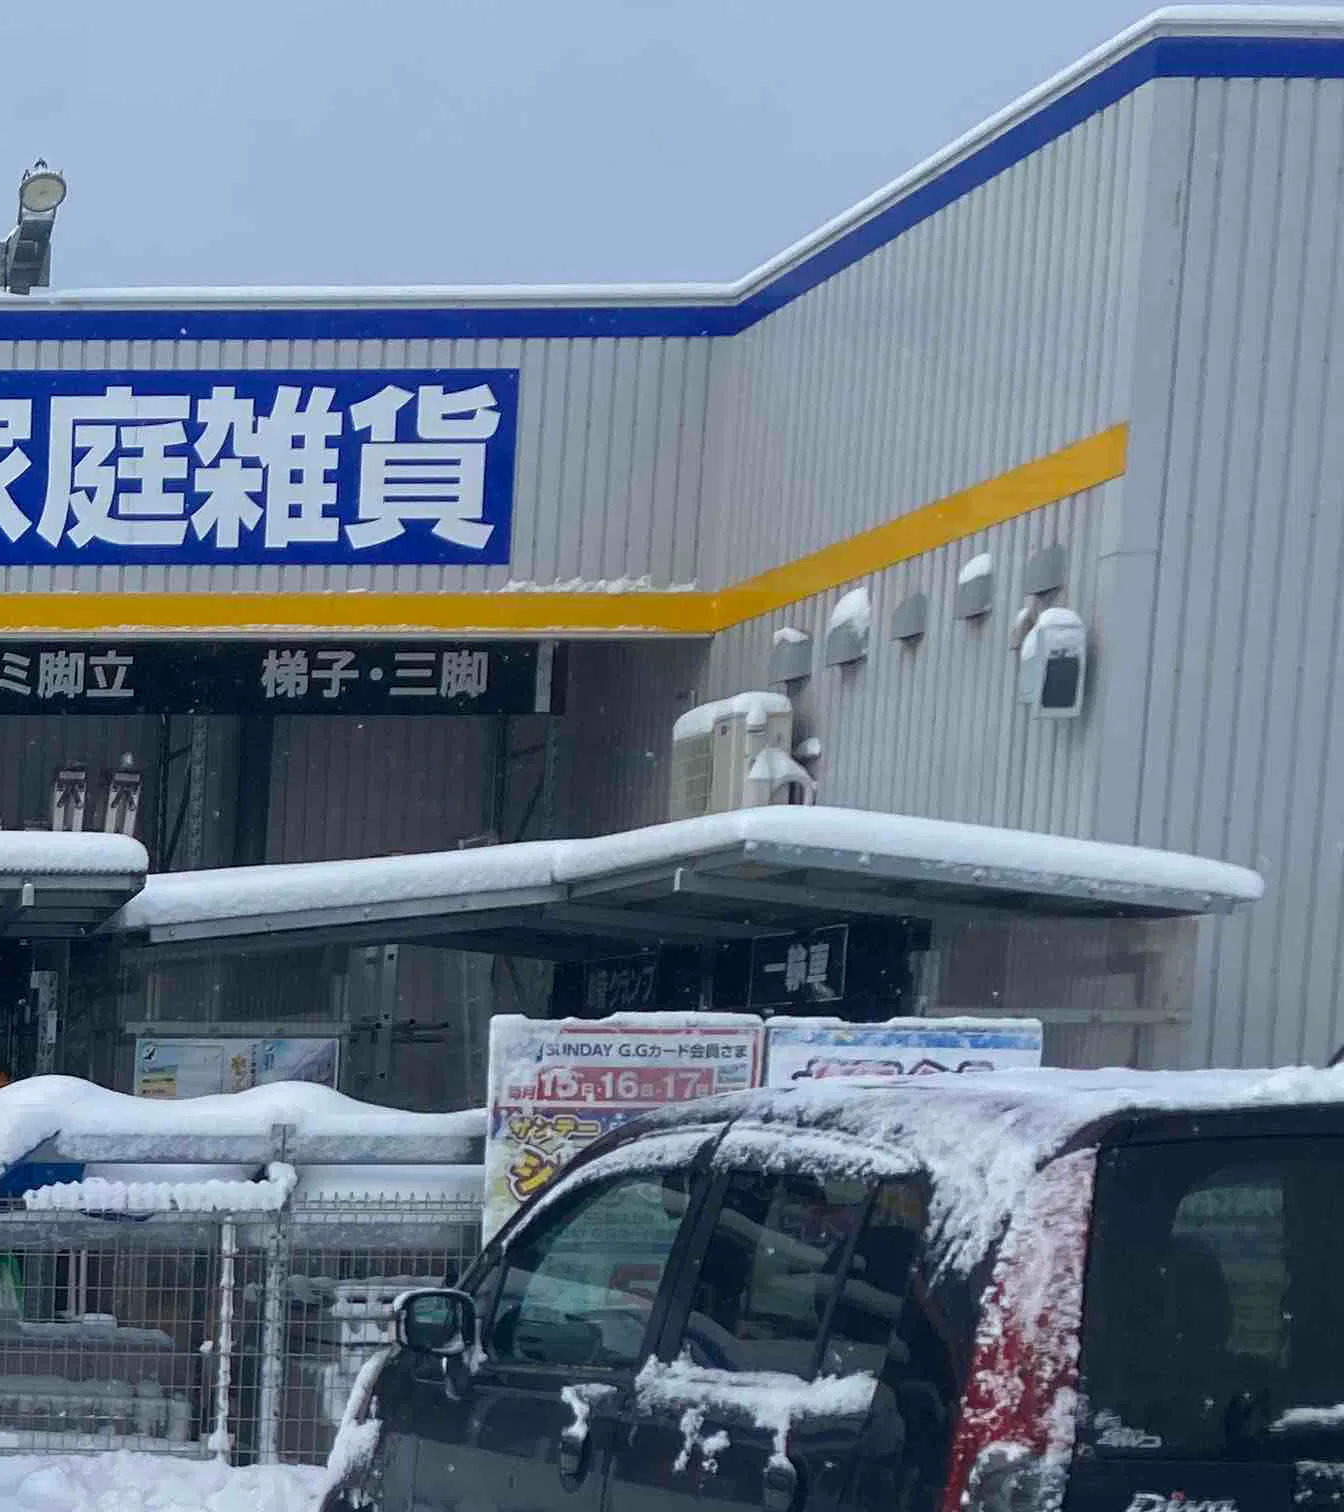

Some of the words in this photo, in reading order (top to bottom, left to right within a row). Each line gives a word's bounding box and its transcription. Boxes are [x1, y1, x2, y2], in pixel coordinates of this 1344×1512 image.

[261, 649, 489, 698] 梯子・三脚
